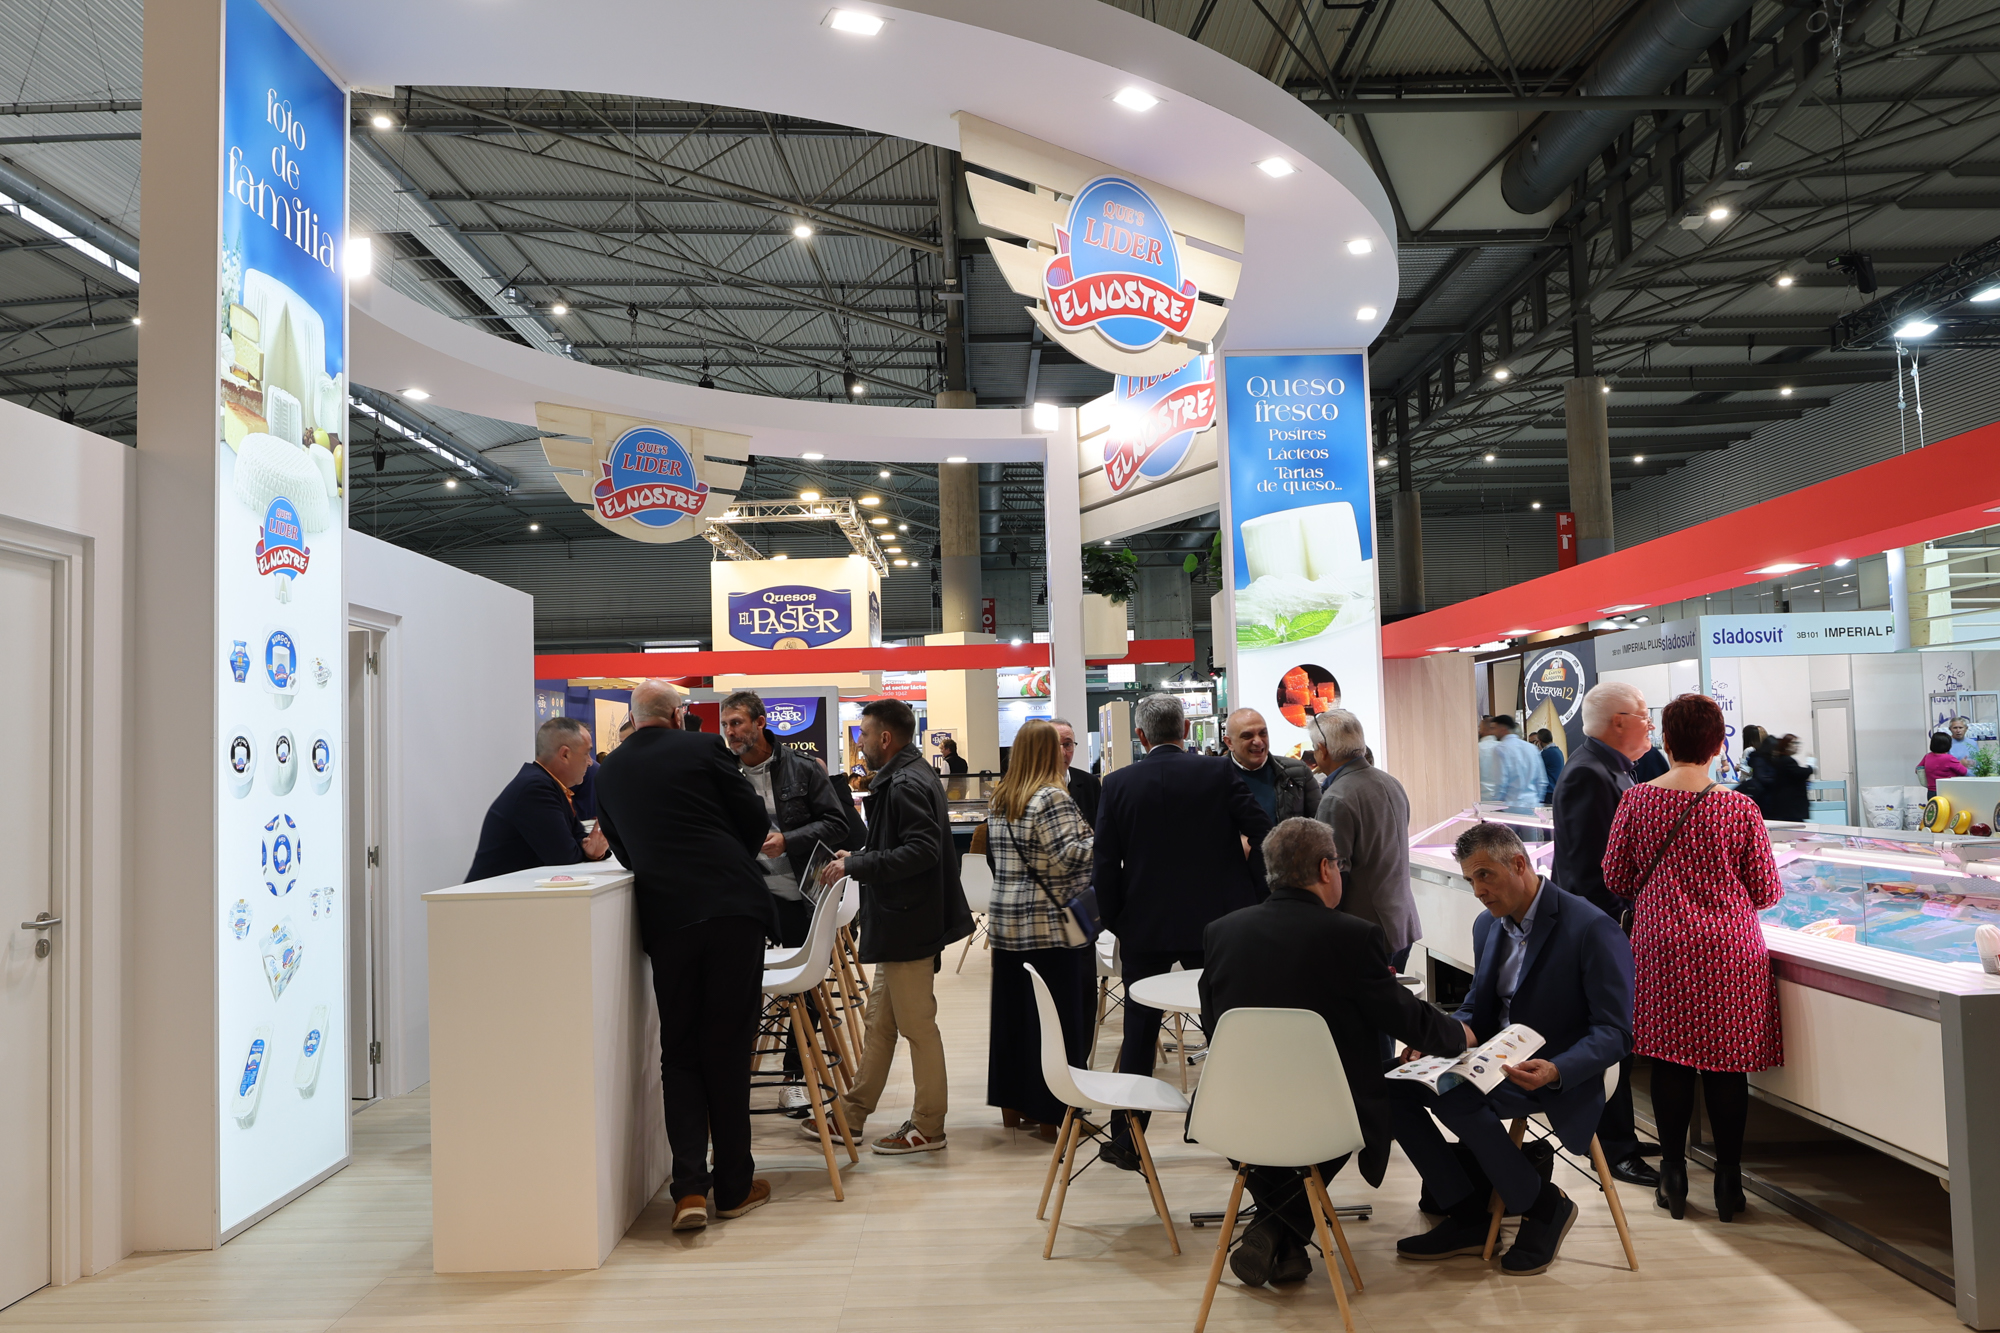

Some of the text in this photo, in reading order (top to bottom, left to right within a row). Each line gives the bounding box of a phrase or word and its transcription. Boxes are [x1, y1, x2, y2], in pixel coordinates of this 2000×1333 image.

[266, 88, 306, 150] foto
[271, 145, 300, 190] de
[228, 146, 336, 273] familia
[1103, 200, 1145, 226] QUE'S
[1083, 217, 1163, 266] LIDER
[1058, 279, 1185, 322] EL NOSTRE
[1246, 376, 1345, 398] Queso
[1255, 400, 1339, 422] fresco
[1269, 427, 1327, 441] Postres
[621, 453, 682, 477] LIDER
[1268, 447, 1329, 461] Lácteos
[1274, 466, 1324, 479] Tartas
[1256, 480, 1342, 495] de queso...
[603, 487, 699, 517] EL NOSTRE
[268, 518, 298, 541] LIDER
[259, 549, 305, 574] EL NOSTRE
[763, 592, 817, 604] Quesos
[738, 603, 842, 634] EL PASTOR
[1622, 641, 1647, 654] IMPERIAL
[1647, 638, 1662, 650] PLUS
[1661, 630, 1696, 651] sladosvit
[1824, 626, 1883, 638] IMPERIAL
[771, 710, 802, 721] PASTOR
